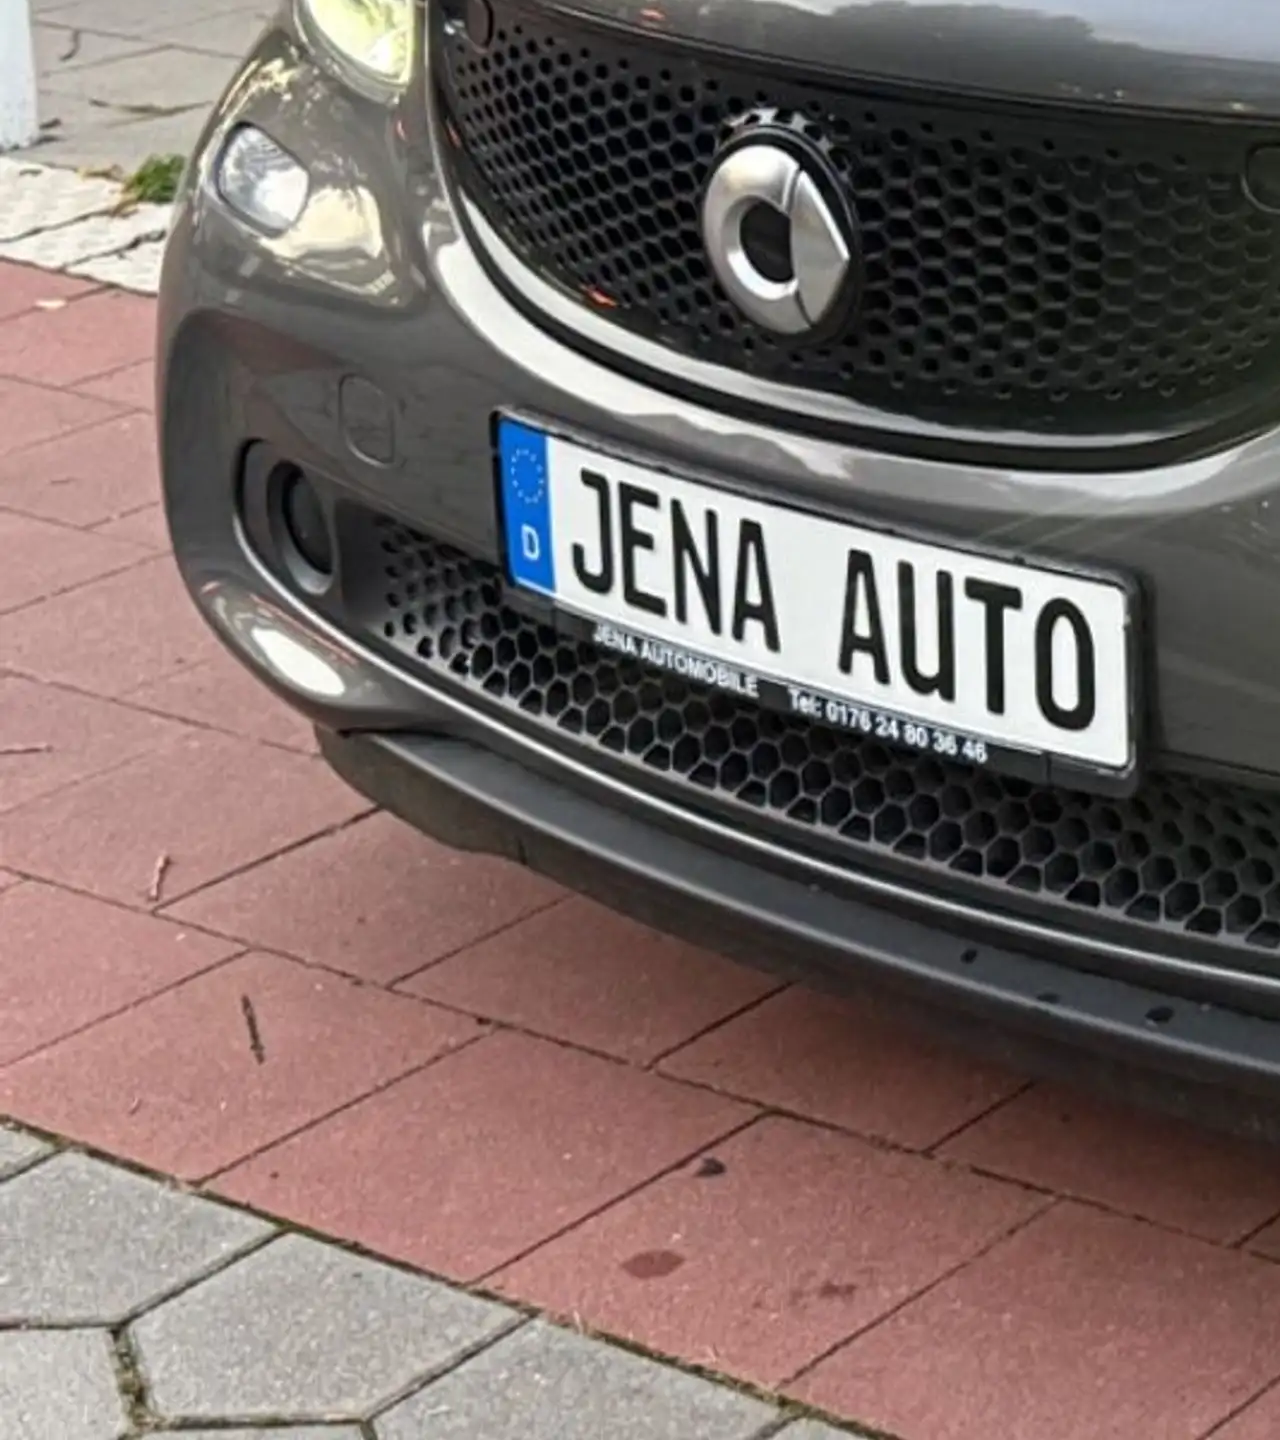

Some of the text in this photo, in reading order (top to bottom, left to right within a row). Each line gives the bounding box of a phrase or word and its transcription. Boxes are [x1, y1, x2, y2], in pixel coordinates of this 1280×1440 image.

[521, 523, 541, 561] D
[571, 467, 1097, 733] JENA AUTO
[592, 621, 639, 656] JENA
[641, 639, 760, 698] AUTOMOBILE
[787, 687, 823, 719] Tel:
[825, 702, 872, 733] 0176
[874, 716, 900, 740] 24
[903, 724, 929, 749] 80
